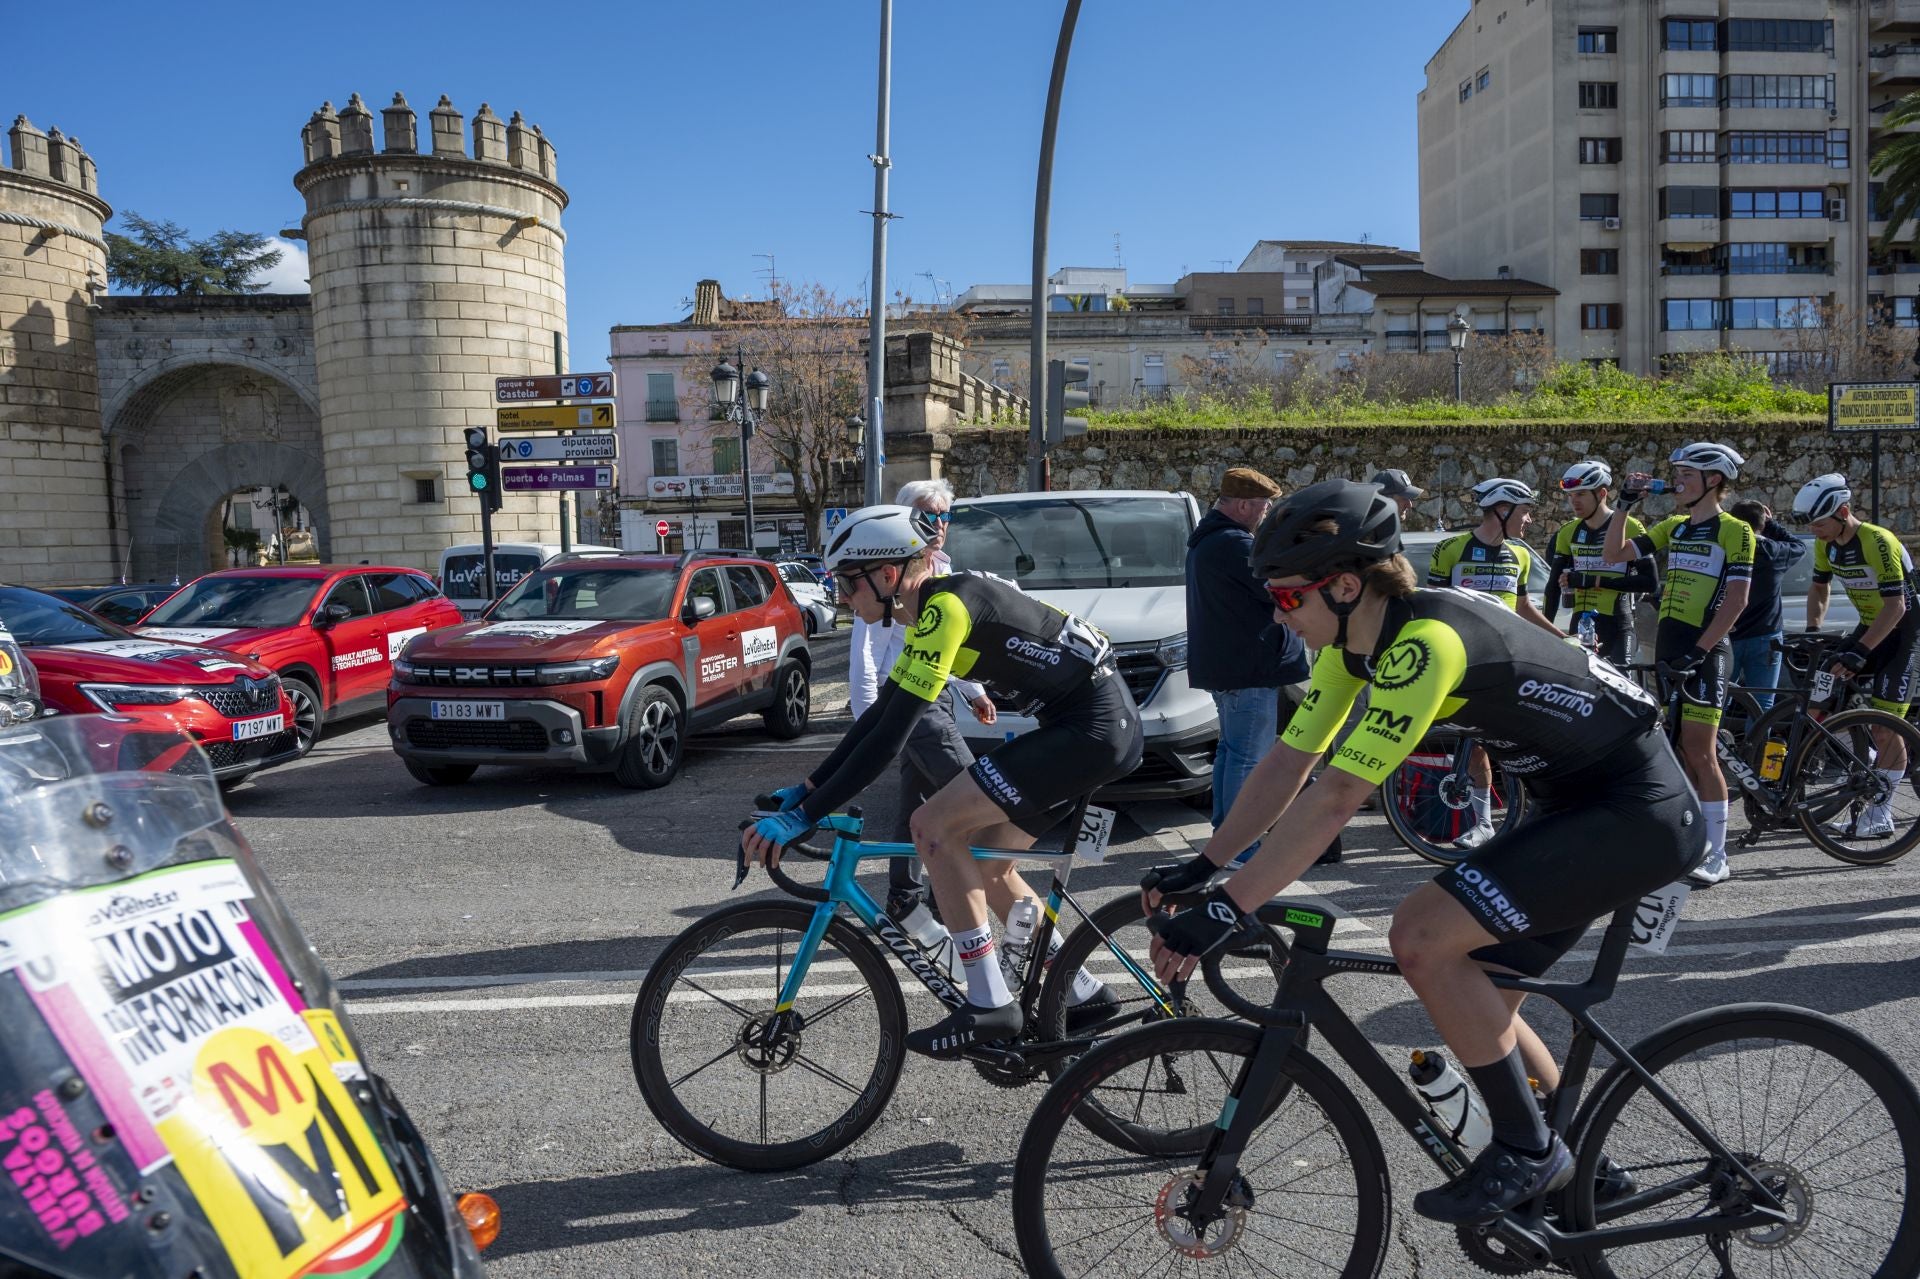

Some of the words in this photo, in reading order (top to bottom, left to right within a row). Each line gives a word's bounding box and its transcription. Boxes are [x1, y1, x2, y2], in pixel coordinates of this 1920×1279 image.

[498, 381, 522, 389] parque
[500, 390, 539, 399] Castelar
[1852, 391, 1872, 401] AVENIDA
[500, 411, 519, 420] hotel
[1840, 404, 1864, 417] FRANCISCO
[1865, 403, 1881, 417] ELADIO
[561, 436, 612, 448] diputación
[565, 446, 612, 457] provincial
[505, 474, 533, 483] puerta
[537, 474, 547, 482] de
[552, 473, 584, 482] Palmas
[844, 546, 908, 556] S-WORKS
[332, 651, 355, 663] RENAULT
[356, 647, 379, 658] AUSTRAL
[332, 660, 352, 671] E-TECH
[351, 657, 365, 668] FULL
[364, 654, 383, 665] HYBRID
[701, 656, 738, 676] DUSTER
[1818, 673, 1833, 695] 146
[440, 704, 472, 717] 3183
[476, 704, 501, 717] MWT
[240, 721, 264, 737] 7197
[266, 716, 282, 733] MWT
[1078, 810, 1103, 844] 126
[1454, 861, 1531, 933] LOURIÑA
[1455, 880, 1493, 918] CYCLING
[1491, 914, 1511, 933] TEAM
[1287, 908, 1322, 924] KNOXY
[98, 908, 222, 989] MOTO
[646, 925, 735, 1046] CORIMA
[932, 1030, 976, 1051] GOBIK
[808, 1030, 894, 1149] CORIMA
[7, 1106, 106, 1237] BURGOS
[3, 1144, 78, 1250] VUELTA
